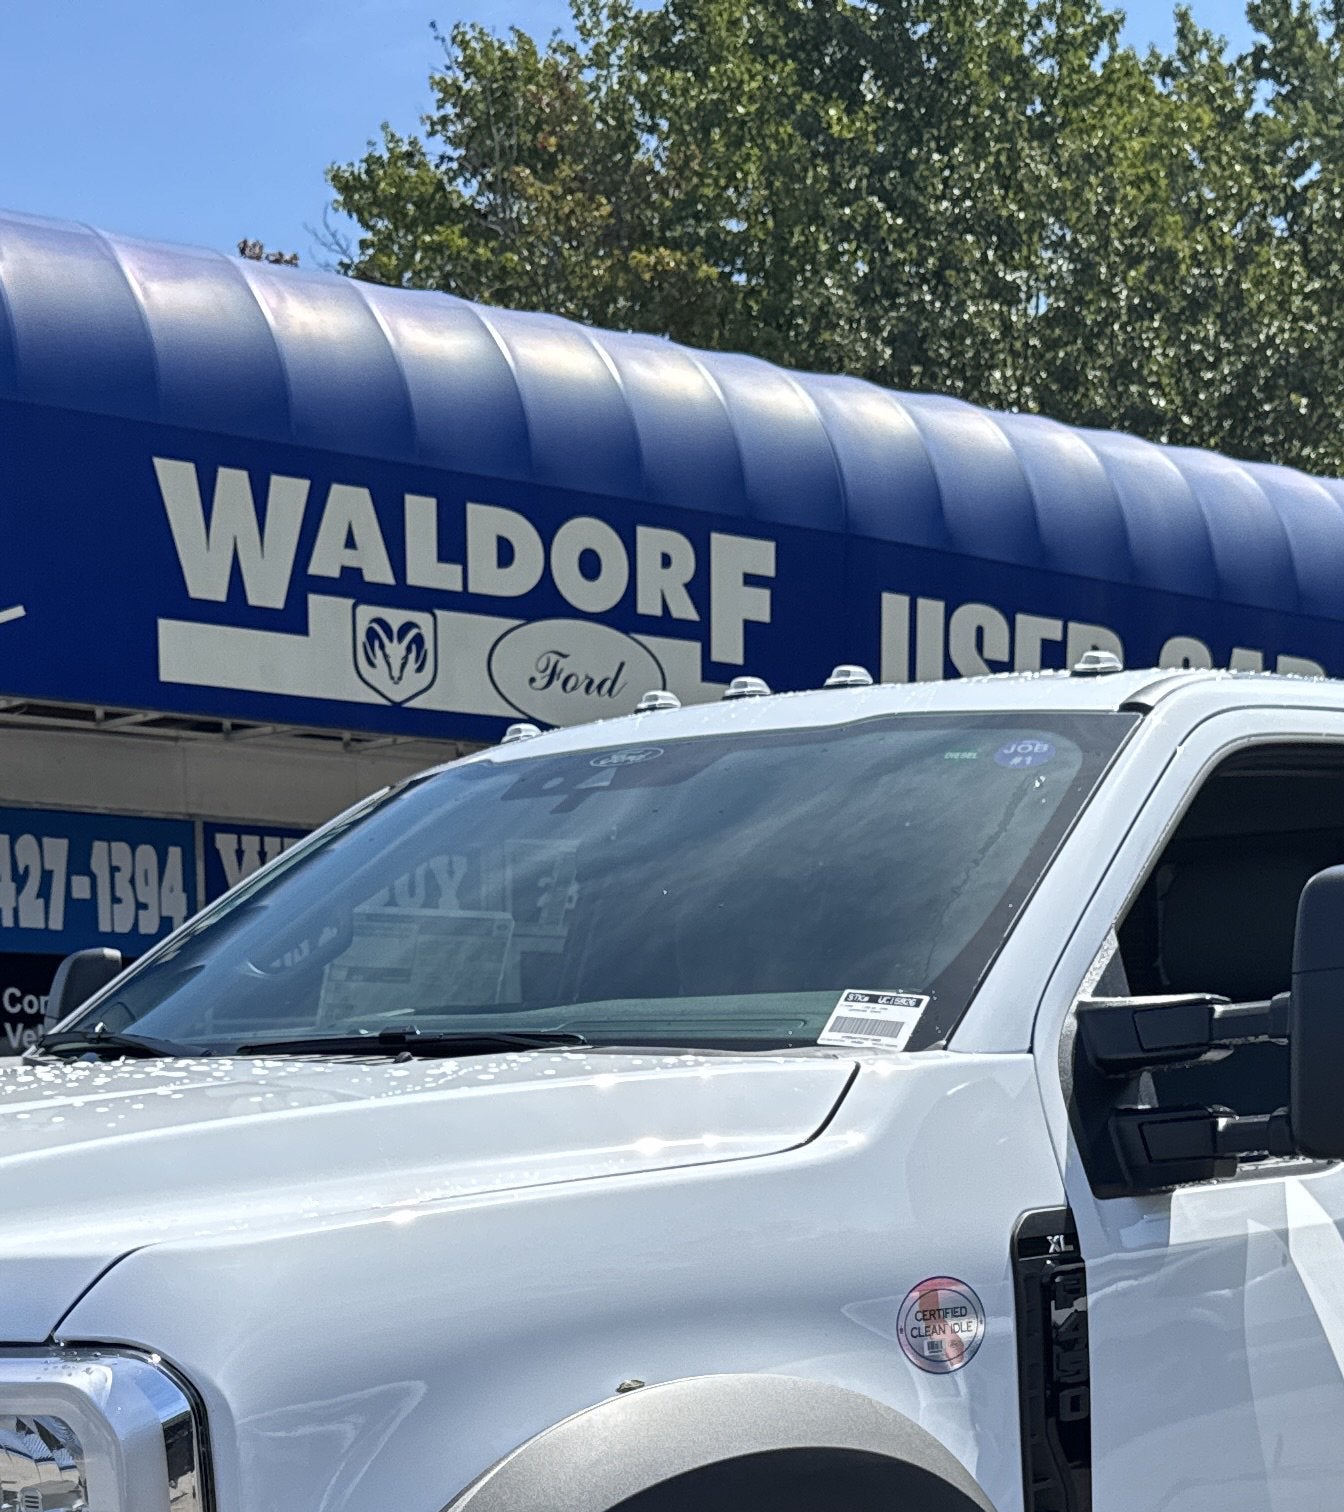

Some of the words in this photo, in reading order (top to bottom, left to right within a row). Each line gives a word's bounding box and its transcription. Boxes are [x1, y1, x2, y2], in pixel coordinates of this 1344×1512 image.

[153, 457, 777, 666] WALDORF
[527, 649, 628, 700] Ford
[1003, 743, 1049, 754] JOB
[1046, 1234, 1074, 1254] XL
[914, 1305, 968, 1322] CERTIFIED
[910, 1324, 946, 1339] CLEAN
[950, 1320, 973, 1335] IDLE
